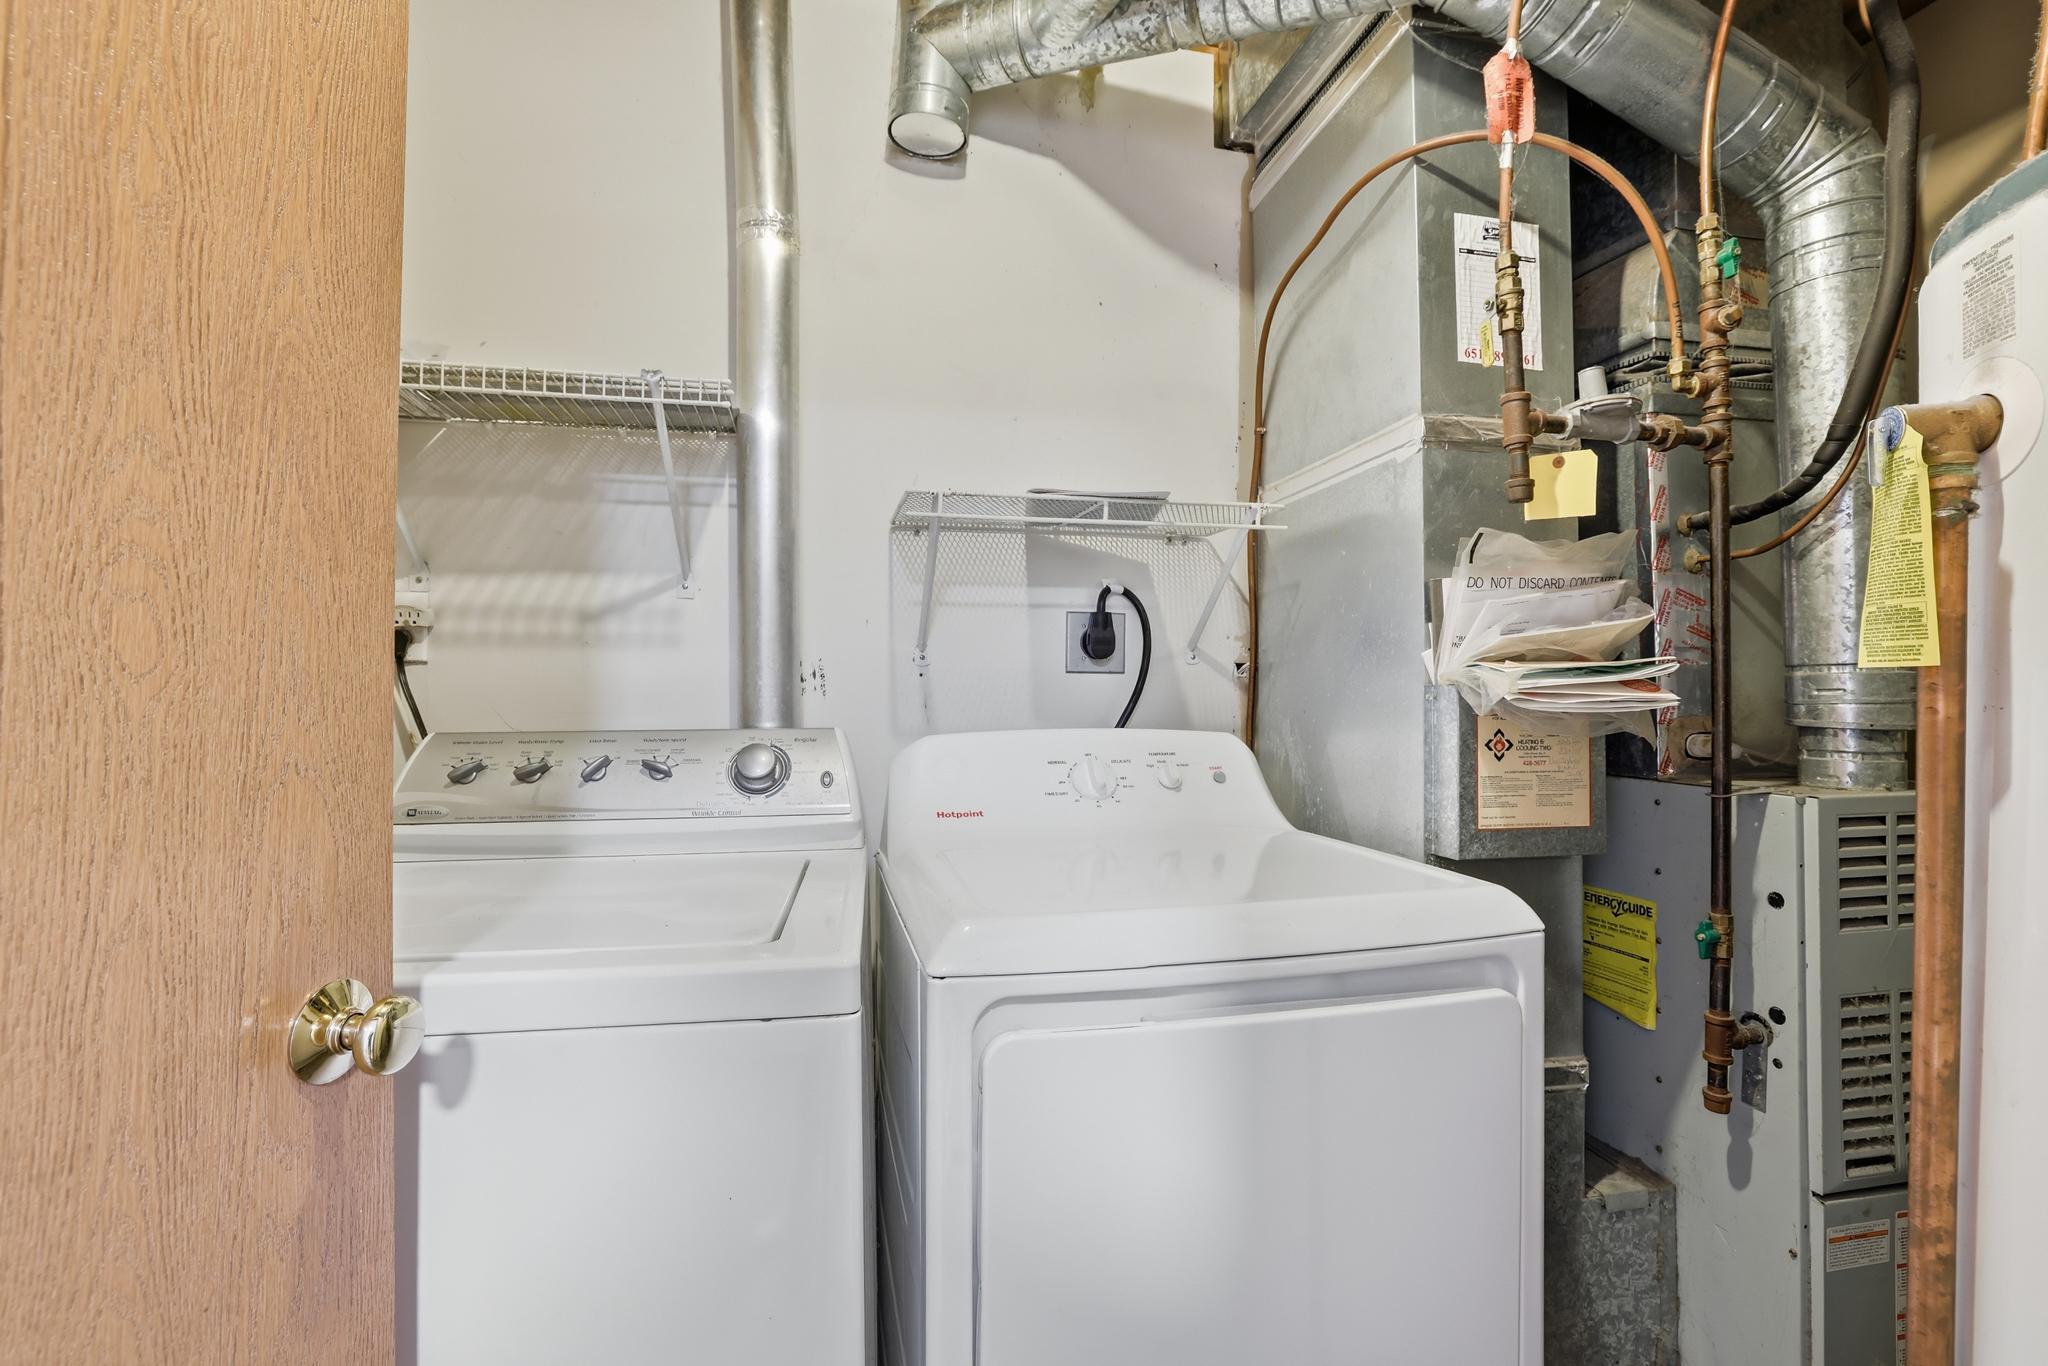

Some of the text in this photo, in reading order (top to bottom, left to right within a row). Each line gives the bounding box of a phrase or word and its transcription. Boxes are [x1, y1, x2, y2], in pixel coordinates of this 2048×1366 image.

[1466, 576, 1484, 589] DO
[1490, 576, 1513, 589] NOT
[1518, 577, 1565, 590] DISCARD
[936, 810, 984, 819] Hotpoint
[1584, 891, 1653, 917] ENERGYGUIDE
